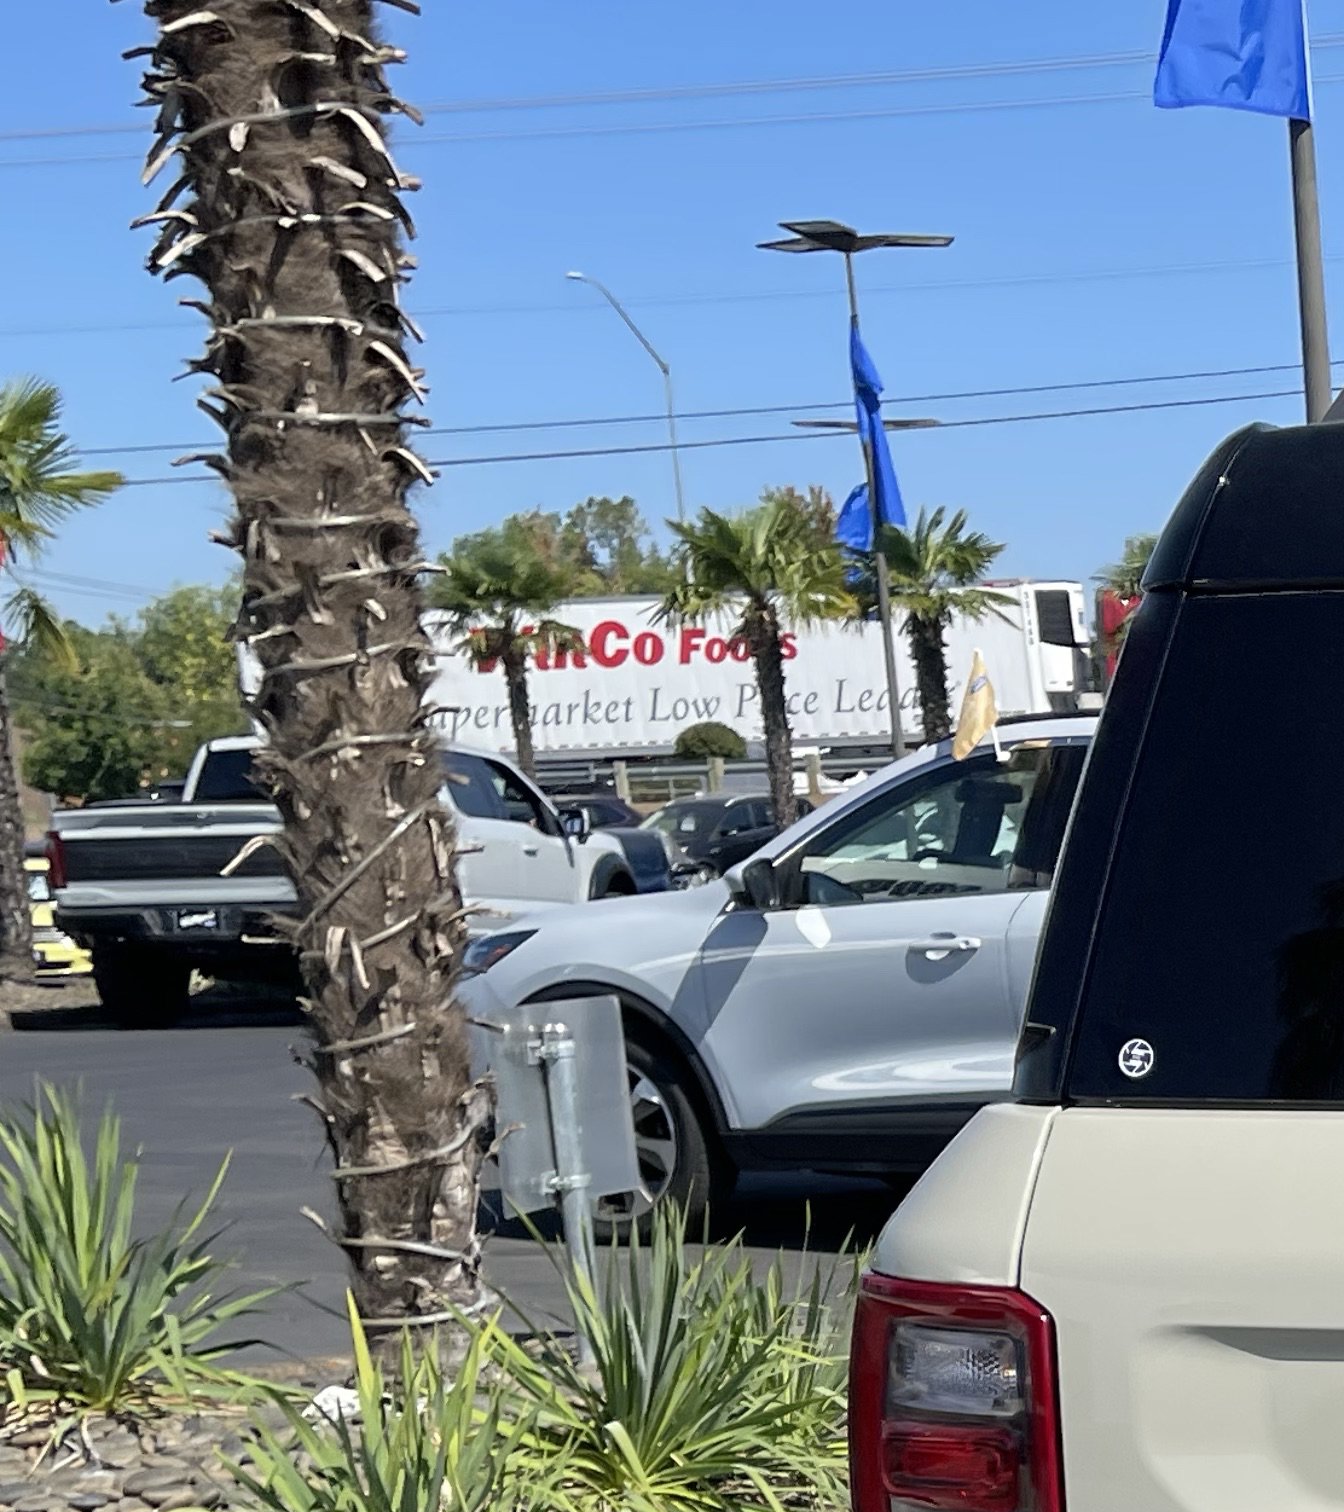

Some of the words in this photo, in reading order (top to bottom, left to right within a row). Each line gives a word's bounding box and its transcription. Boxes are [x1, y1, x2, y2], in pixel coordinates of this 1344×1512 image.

[679, 627, 797, 665] Foos
[429, 688, 634, 736] uperarket
[648, 687, 721, 722] Low
[733, 683, 819, 719] Pce
